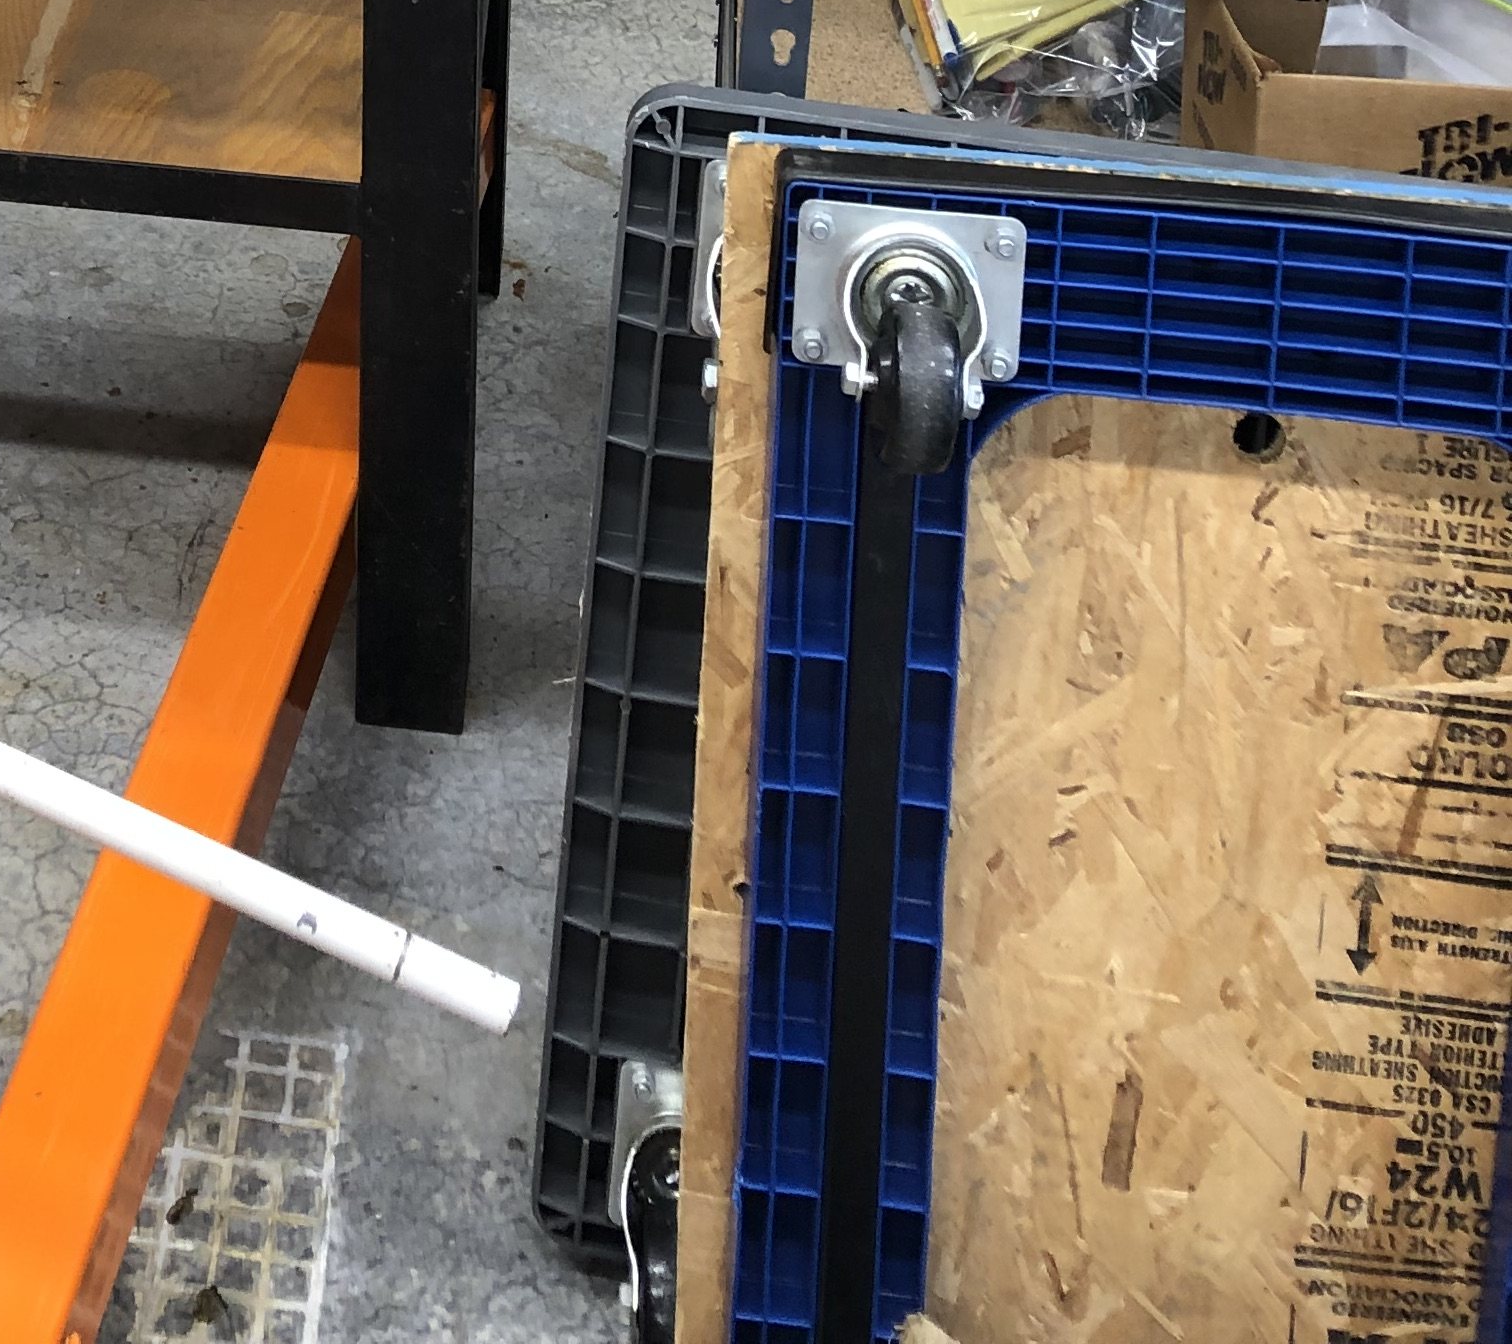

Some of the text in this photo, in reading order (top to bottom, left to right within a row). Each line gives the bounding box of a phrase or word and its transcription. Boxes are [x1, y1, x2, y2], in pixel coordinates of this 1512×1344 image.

[1439, 494, 1496, 520] 7/16
[1400, 1014, 1498, 1046] ADHESIVE
[1368, 1034, 1420, 1060] TYPE
[1312, 1050, 1419, 1083] SHEATHING
[1410, 1110, 1465, 1141] 450
[1386, 1160, 1484, 1204] W24
